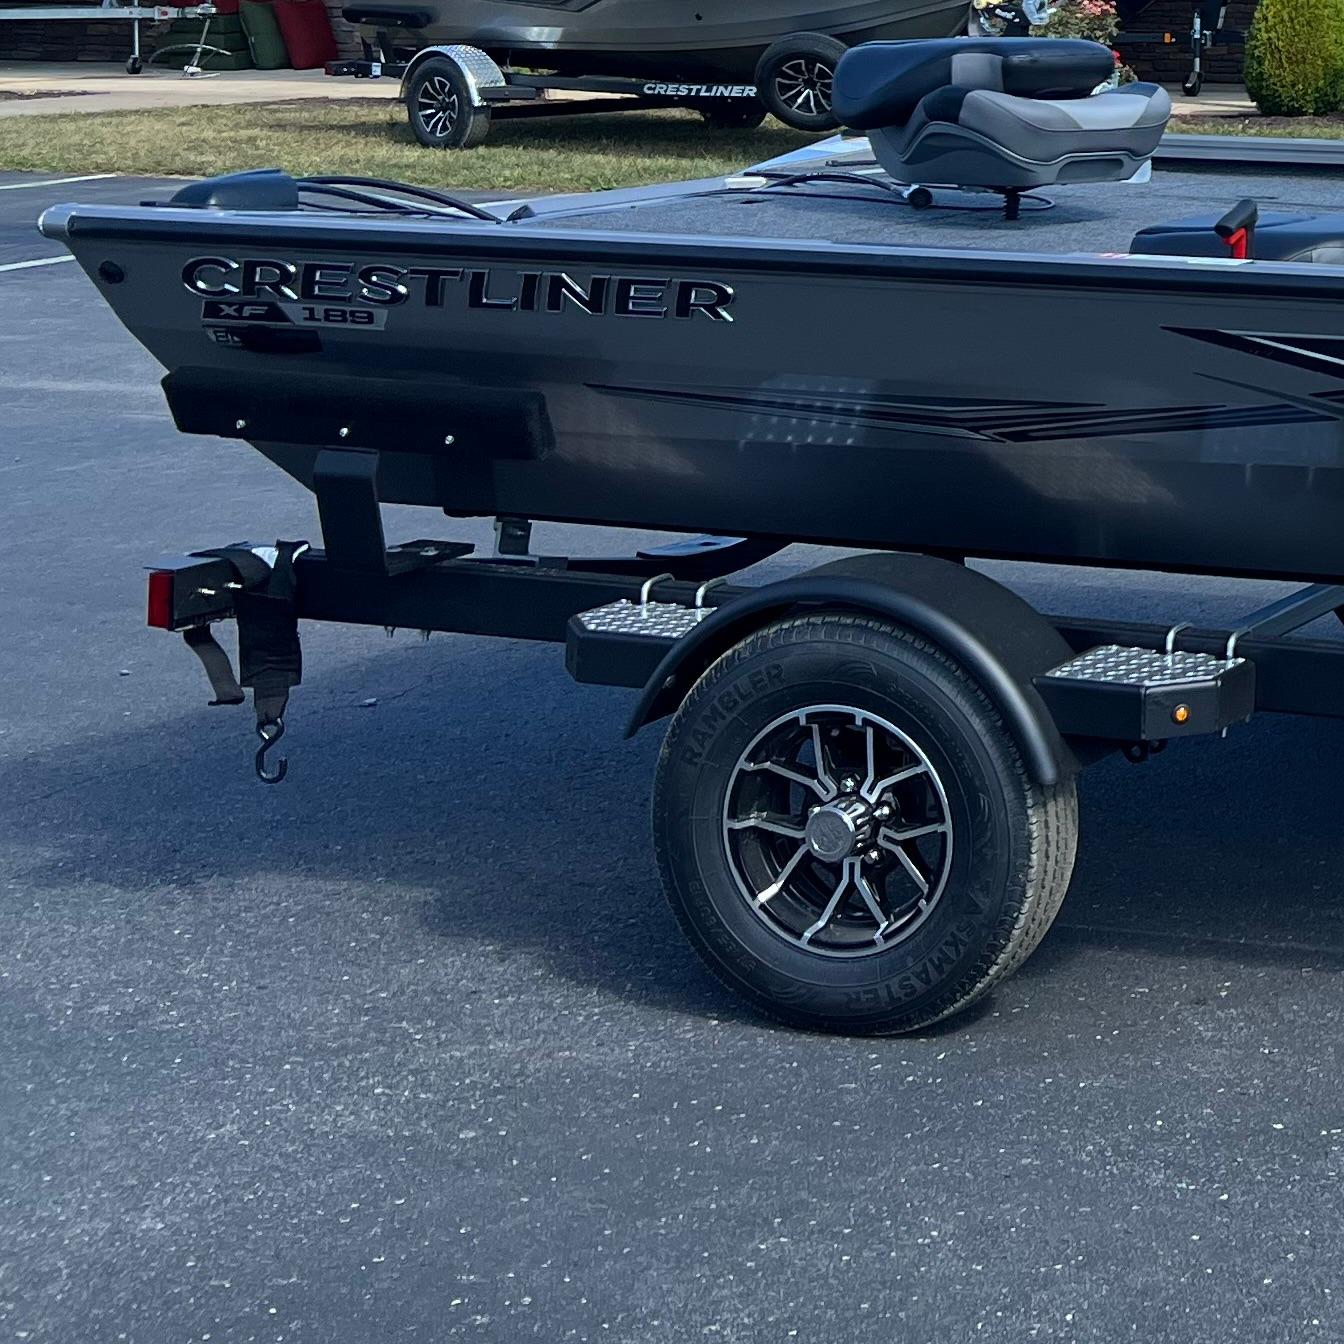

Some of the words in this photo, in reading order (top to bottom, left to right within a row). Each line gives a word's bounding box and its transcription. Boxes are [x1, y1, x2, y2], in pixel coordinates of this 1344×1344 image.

[643, 83, 758, 97] CRESTLINER
[181, 255, 734, 322] CRESTLINER
[217, 304, 268, 317] XF
[302, 306, 375, 325] 189
[680, 662, 786, 766] RAMBLER
